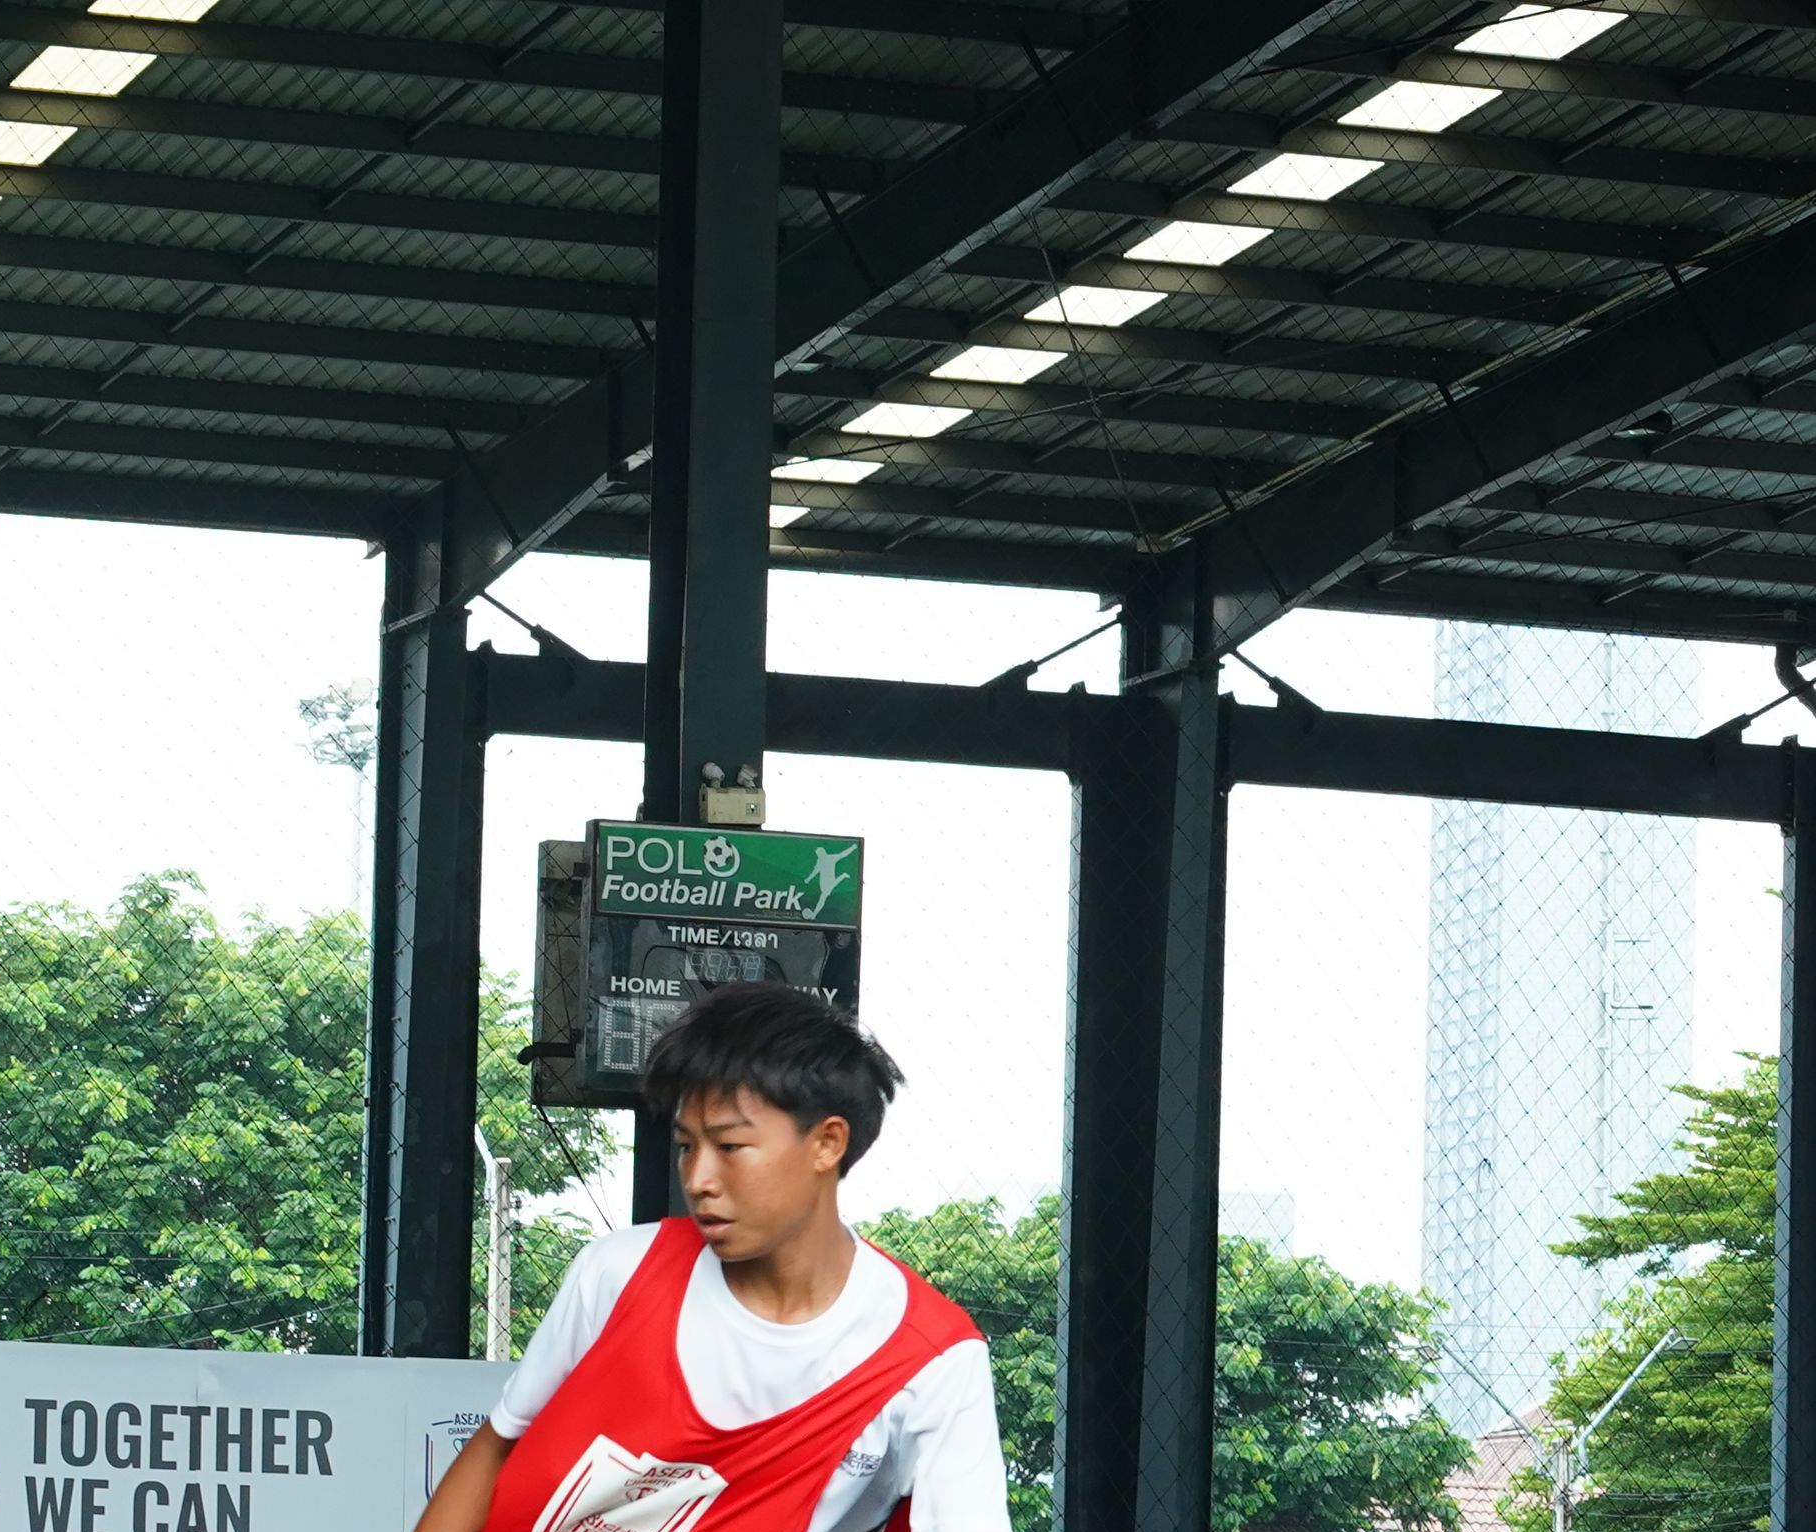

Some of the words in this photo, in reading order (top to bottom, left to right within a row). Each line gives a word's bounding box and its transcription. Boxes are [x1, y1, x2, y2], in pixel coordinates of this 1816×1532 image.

[606, 835, 741, 878] POLO
[601, 874, 728, 906] Football
[733, 882, 806, 911] Park
[610, 975, 681, 997] HOME
[24, 1398, 334, 1476] TOGETHER
